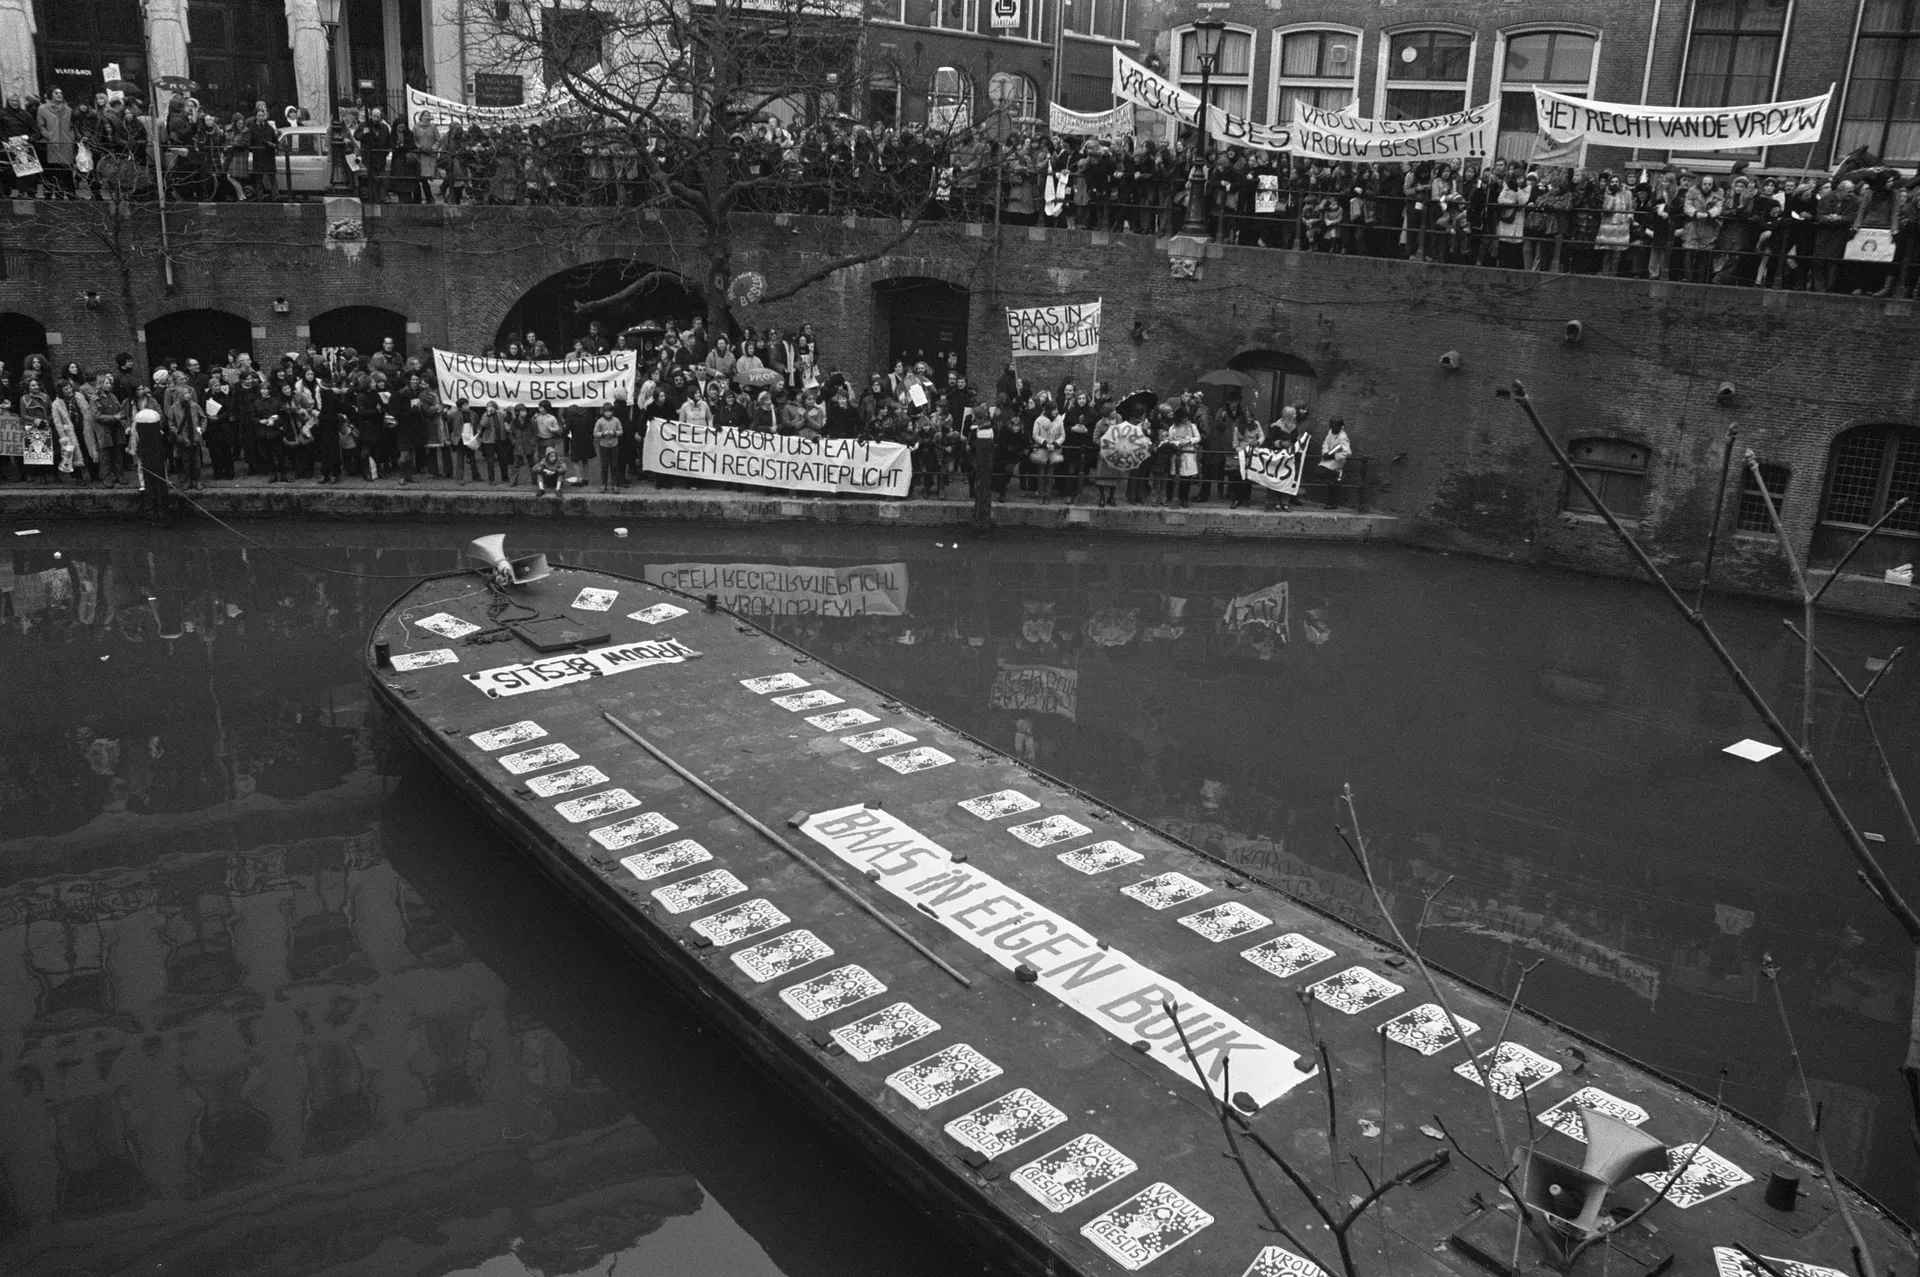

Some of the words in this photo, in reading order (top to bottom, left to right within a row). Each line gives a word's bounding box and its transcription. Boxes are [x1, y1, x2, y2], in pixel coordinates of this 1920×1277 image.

[1301, 104, 1373, 134] VROUW
[1380, 121, 1396, 134] IS
[1541, 100, 1580, 131] HET
[1586, 111, 1654, 139] RECHT
[1734, 97, 1828, 139] VROUW
[1299, 129, 1371, 157] VROUW
[1379, 132, 1463, 158] BESLIST
[1007, 307, 1059, 328] BAAS
[1064, 305, 1081, 324] IN
[1010, 333, 1062, 352] EIGEN
[1065, 327, 1100, 350] BUIK
[440, 353, 522, 375] VROUW
[528, 360, 545, 375] IS
[549, 353, 629, 375] MONDIG
[441, 379, 521, 401] VROUW
[530, 379, 609, 401] BESLIST
[659, 421, 718, 445] GEEN
[659, 448, 718, 474] GEEN
[721, 456, 903, 488] REGISTRATIEPLICHT
[602, 641, 694, 666] VROUW
[491, 656, 600, 690] BESLIS
[814, 809, 938, 878] BAAS
[741, 951, 774, 978] BESLIS
[849, 966, 882, 994] VROUW
[791, 988, 826, 1017] BESLIS
[900, 1004, 935, 1034] VROUW
[841, 1029, 877, 1056] BESLIS
[957, 1045, 997, 1078] VROUW
[898, 1071, 938, 1102] BESLIS
[1016, 1089, 1061, 1124] VROUW
[1588, 1092, 1638, 1121] BESLIS
[957, 1121, 1001, 1153] BESLIS
[1083, 1135, 1131, 1173] VROUW
[1025, 1168, 1070, 1204] BESLIS
[1155, 1185, 1206, 1226] VROUW
[1096, 1222, 1147, 1260] BESLIS
